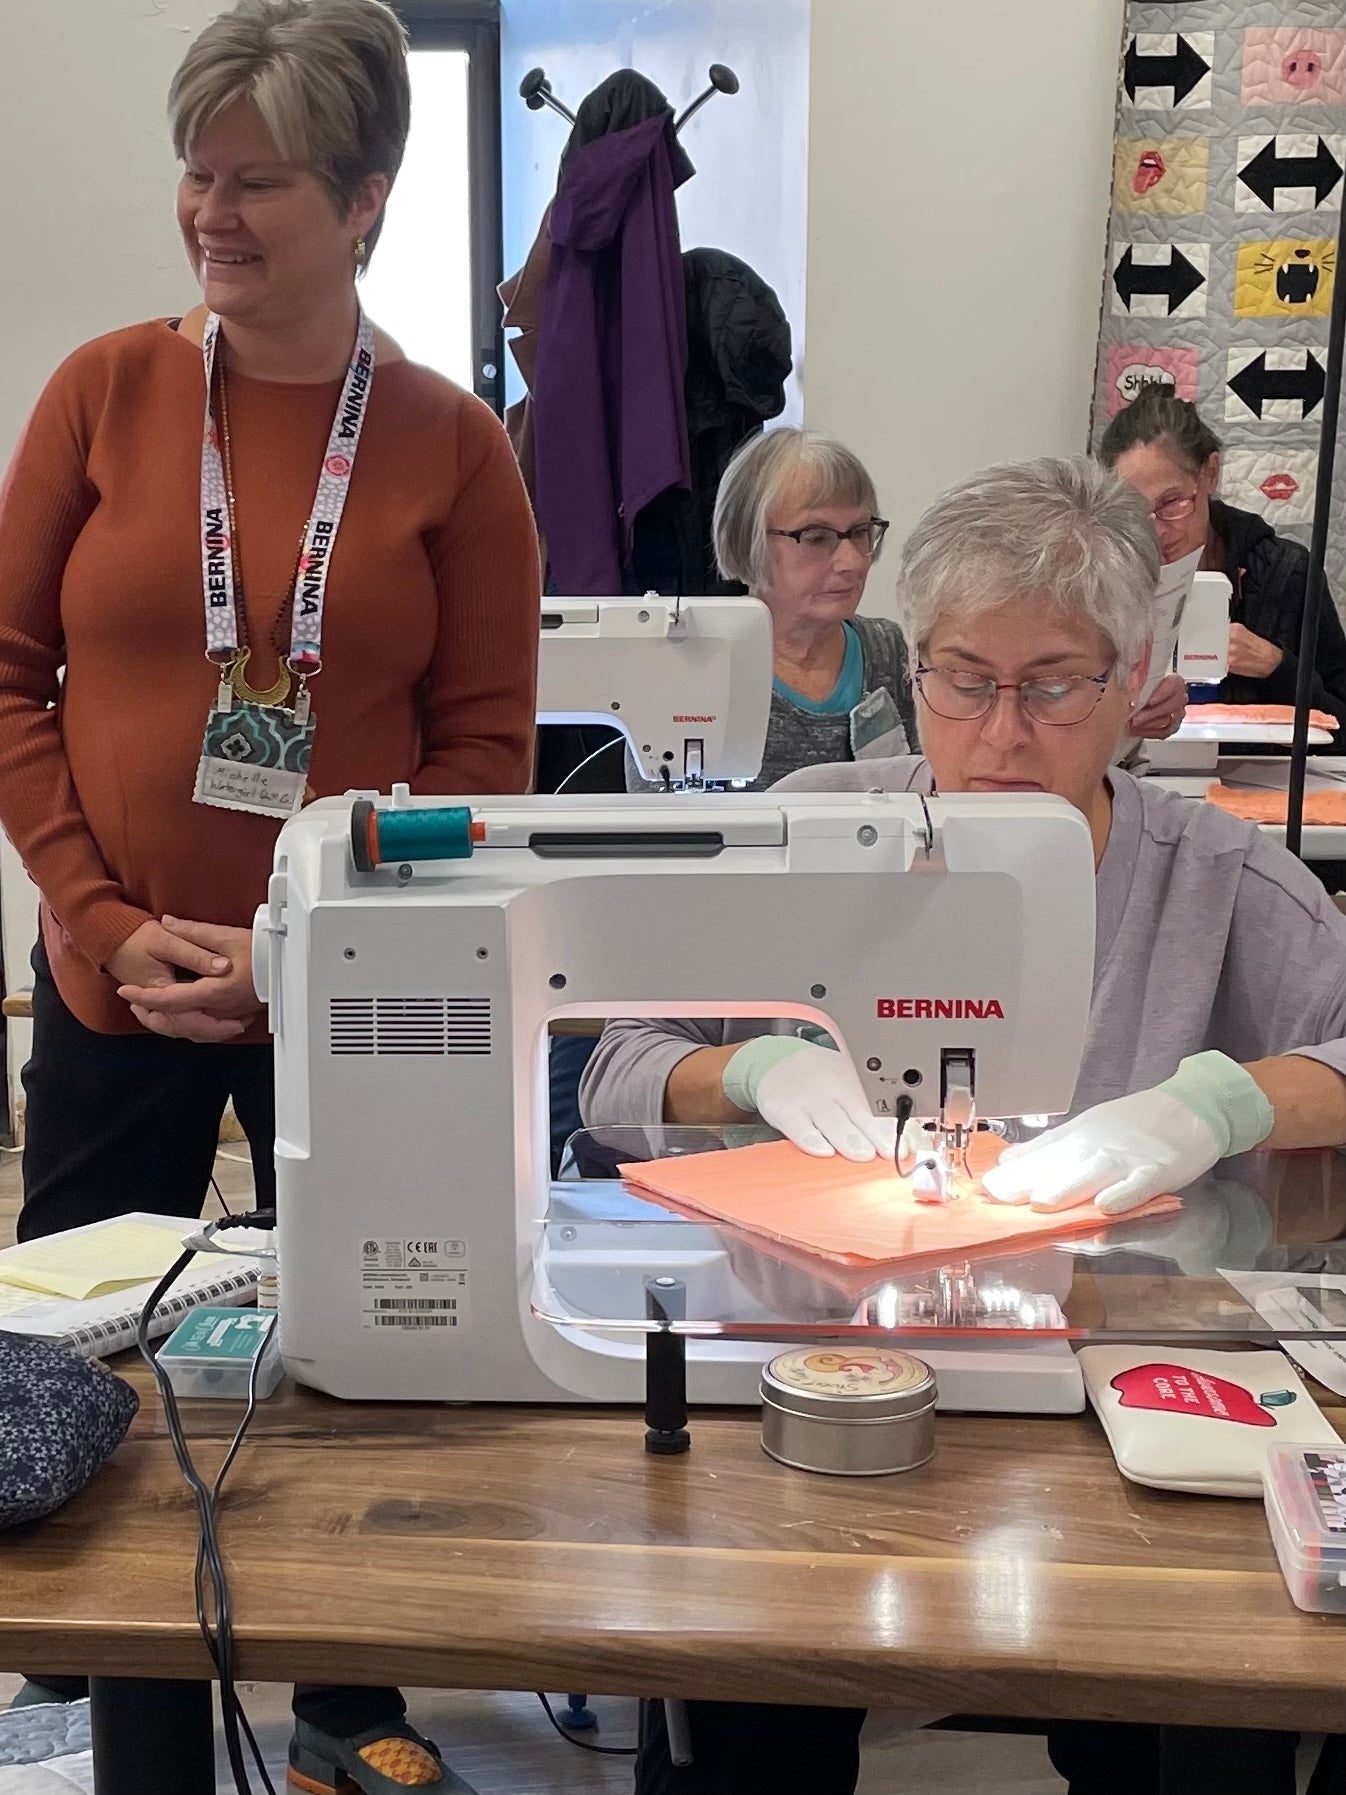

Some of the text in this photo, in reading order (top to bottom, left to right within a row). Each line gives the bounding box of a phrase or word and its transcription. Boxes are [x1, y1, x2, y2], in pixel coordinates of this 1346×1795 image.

[338, 348, 372, 439] BERNINA
[206, 508, 227, 607] BERNINA
[301, 520, 334, 616] BERNINA
[672, 715, 713, 723] BERNINA
[877, 999, 1004, 1019] BERNINA
[1153, 1377, 1177, 1400] CORE
[1179, 1387, 1200, 1404] THE
